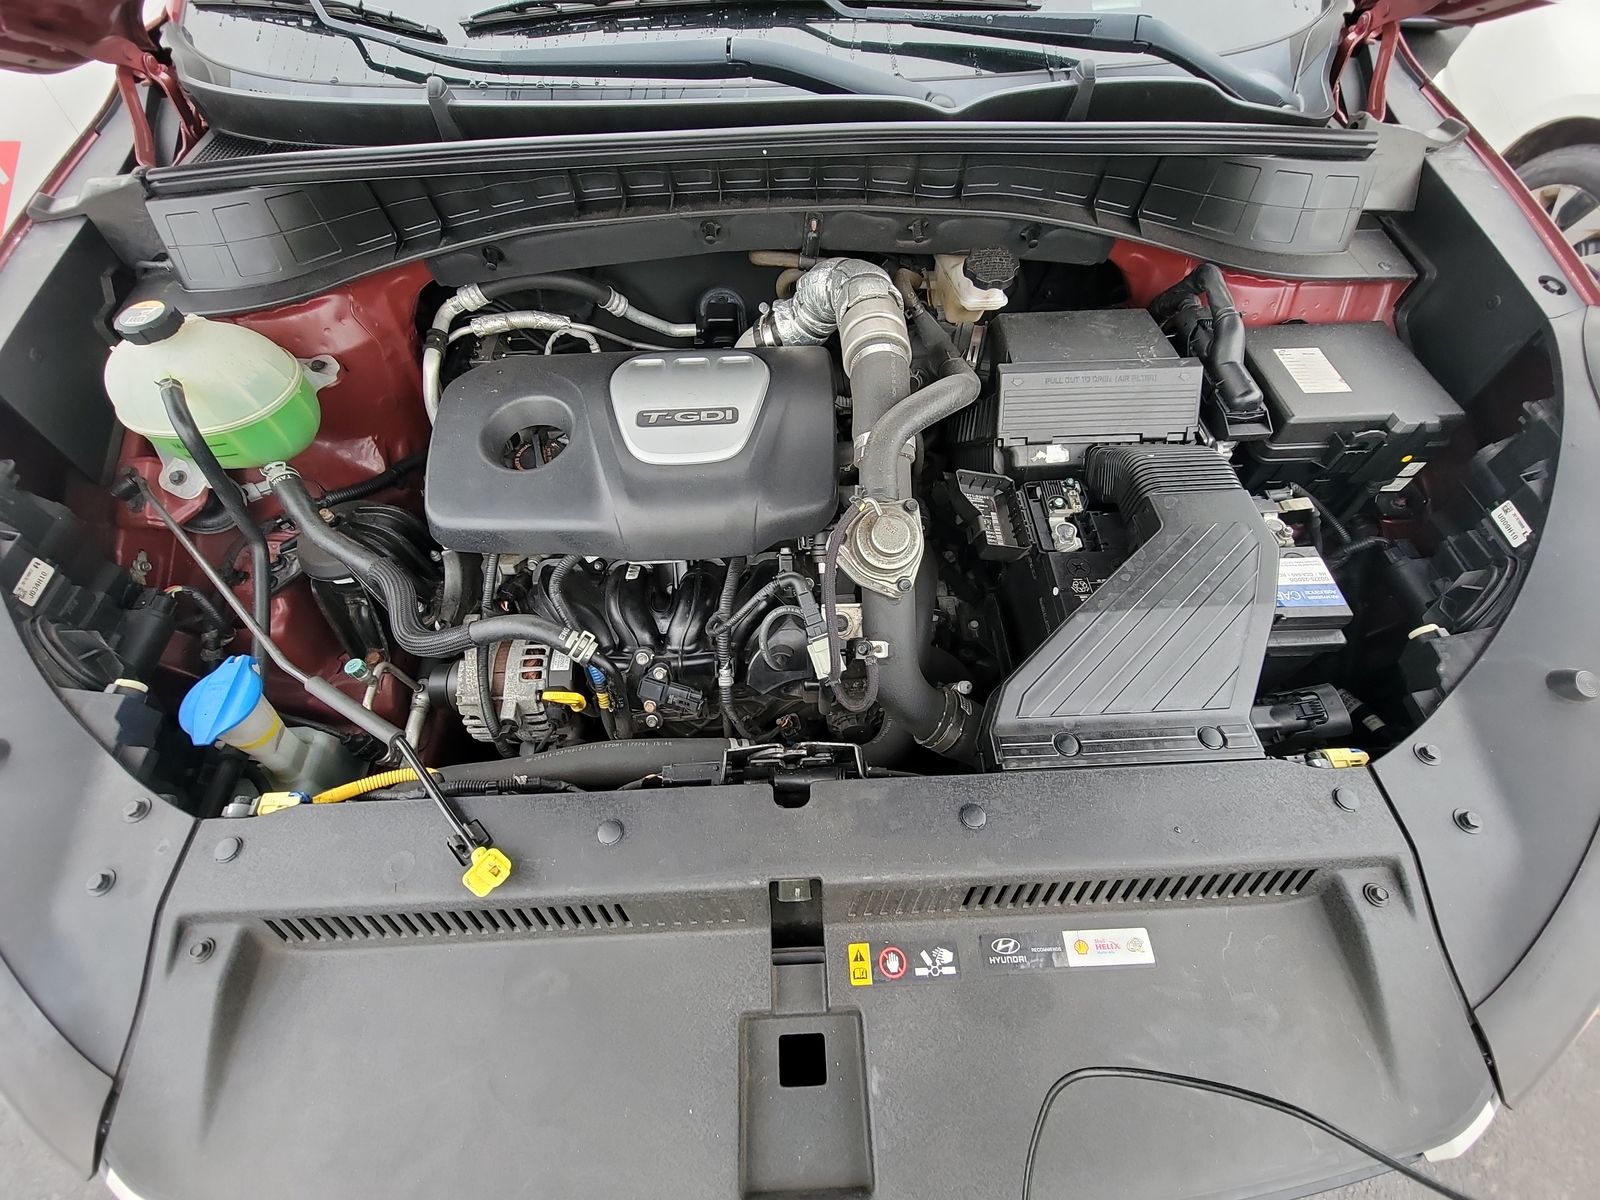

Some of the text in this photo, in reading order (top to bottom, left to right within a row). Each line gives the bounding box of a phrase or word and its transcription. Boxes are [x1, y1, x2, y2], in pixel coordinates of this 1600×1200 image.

[1044, 377, 1064, 385] PULL
[1065, 376, 1080, 384] OUT
[1081, 375, 1091, 383] TO
[1092, 375, 1111, 383] OPEN
[643, 409, 733, 424] T-GDI
[271, 474, 292, 487] TANK
[989, 955, 1027, 964] HYUNDAI
